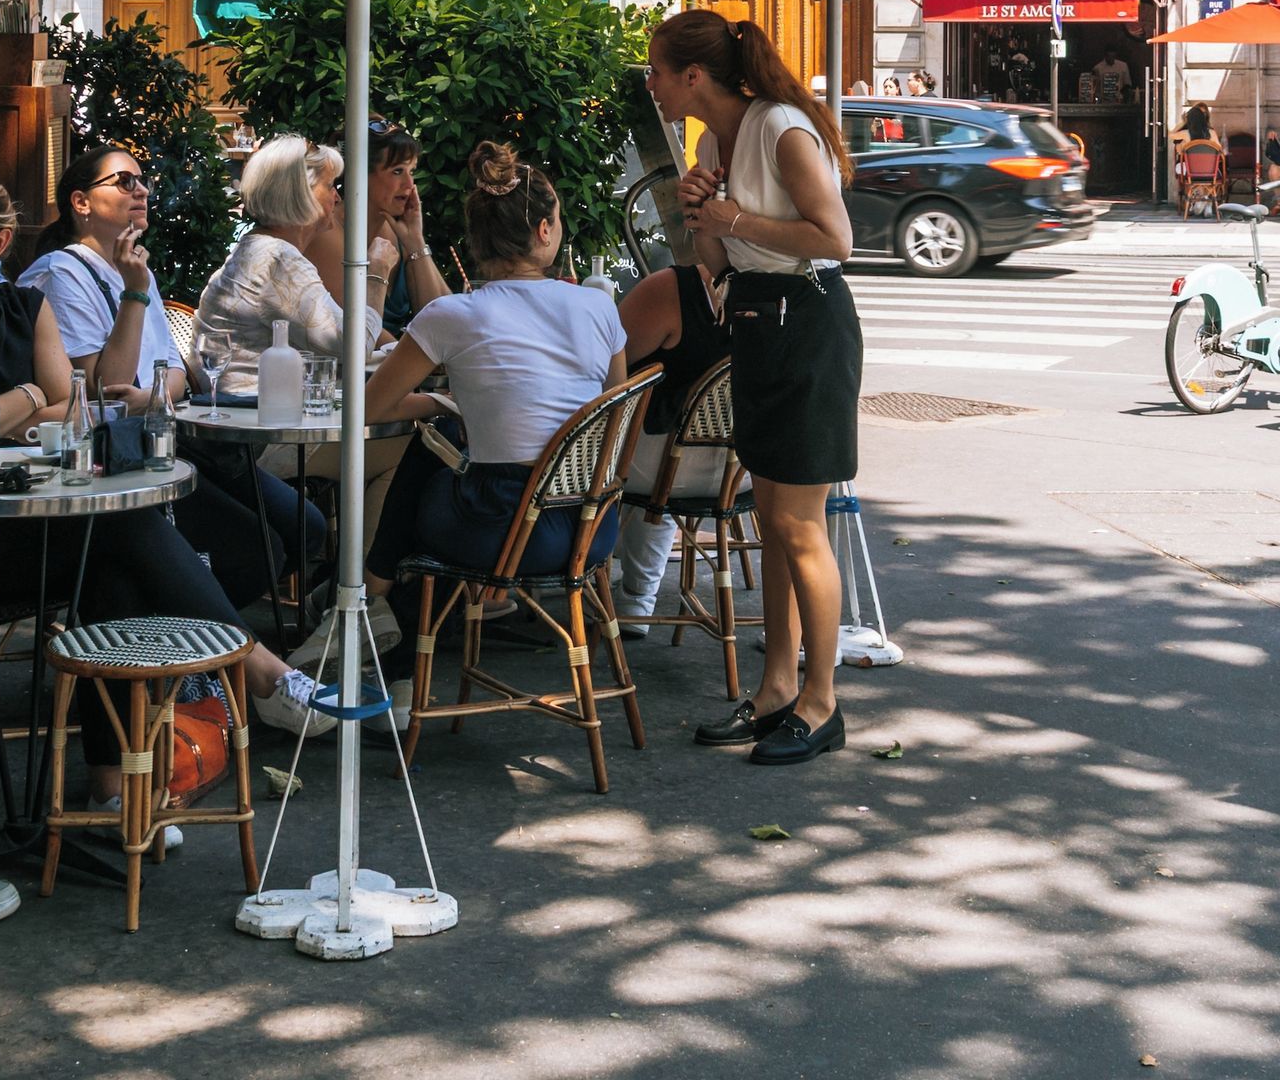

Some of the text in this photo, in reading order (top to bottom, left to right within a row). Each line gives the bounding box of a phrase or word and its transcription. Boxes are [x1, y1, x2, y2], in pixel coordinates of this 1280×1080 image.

[1209, 1, 1223, 9] RUE
[982, 5, 999, 18] LE
[1000, 5, 1018, 18] ST
